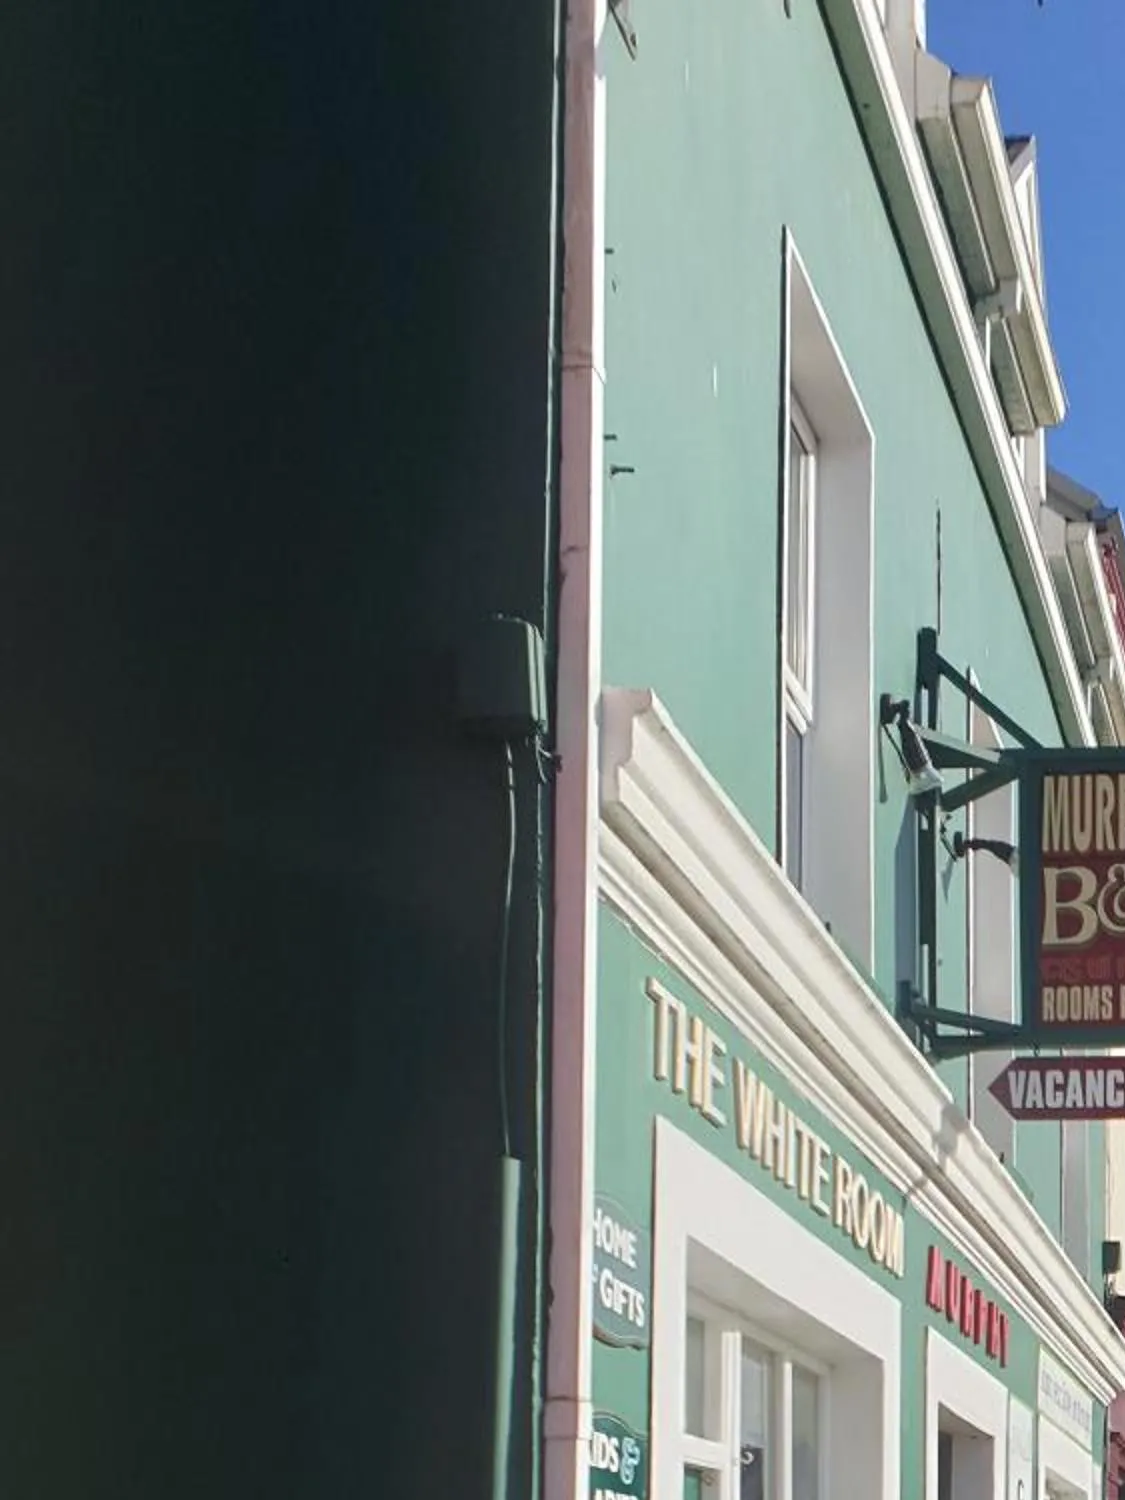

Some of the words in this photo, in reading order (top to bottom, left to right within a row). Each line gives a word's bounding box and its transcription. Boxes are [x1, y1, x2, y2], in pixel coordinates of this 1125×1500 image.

[1042, 985, 1113, 1022] ROOMS
[645, 976, 727, 1128] THE
[733, 1057, 831, 1218] WHITE
[832, 1153, 905, 1279] ROOM
[599, 1268, 645, 1328] GIFTS
[620, 1436, 641, 1485] &
